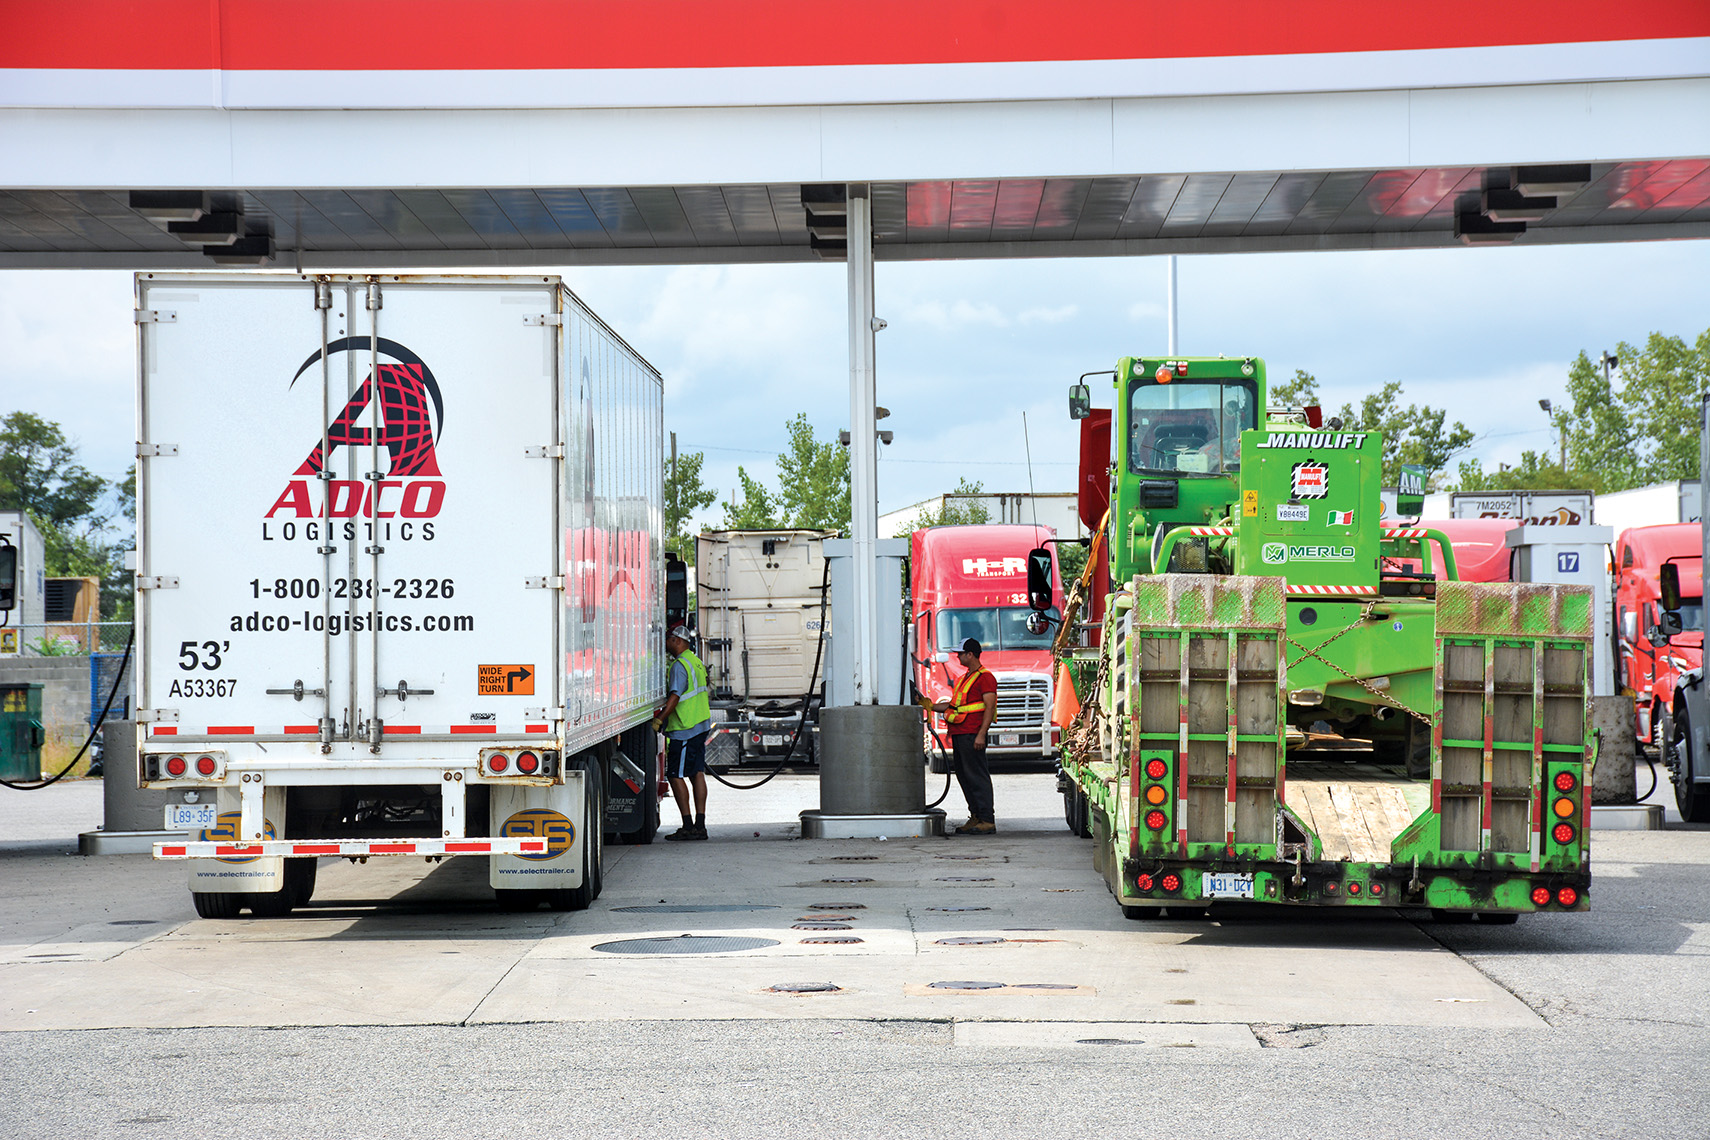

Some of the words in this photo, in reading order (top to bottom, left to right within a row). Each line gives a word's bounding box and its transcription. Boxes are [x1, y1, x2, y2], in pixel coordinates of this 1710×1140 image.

[1257, 433, 1368, 450] MANULIFT
[263, 480, 446, 518] ADCO
[1476, 501, 1512, 511] 7M2052
[262, 522, 435, 541] LOGISTICS
[1290, 546, 1355, 557] MERLO
[1558, 554, 1577, 570] 17
[250, 578, 454, 599] 1-800-238-2326
[230, 611, 474, 636] adco-logistics.com
[806, 620, 830, 630] 6267
[479, 666, 503, 675] WIDE
[479, 675, 507, 684] RIGHT
[169, 679, 237, 698] A53367
[479, 684, 504, 693] TURN
[173, 810, 191, 823] L89
[197, 810, 214, 823] 35F
[1210, 878, 1227, 891] N31
